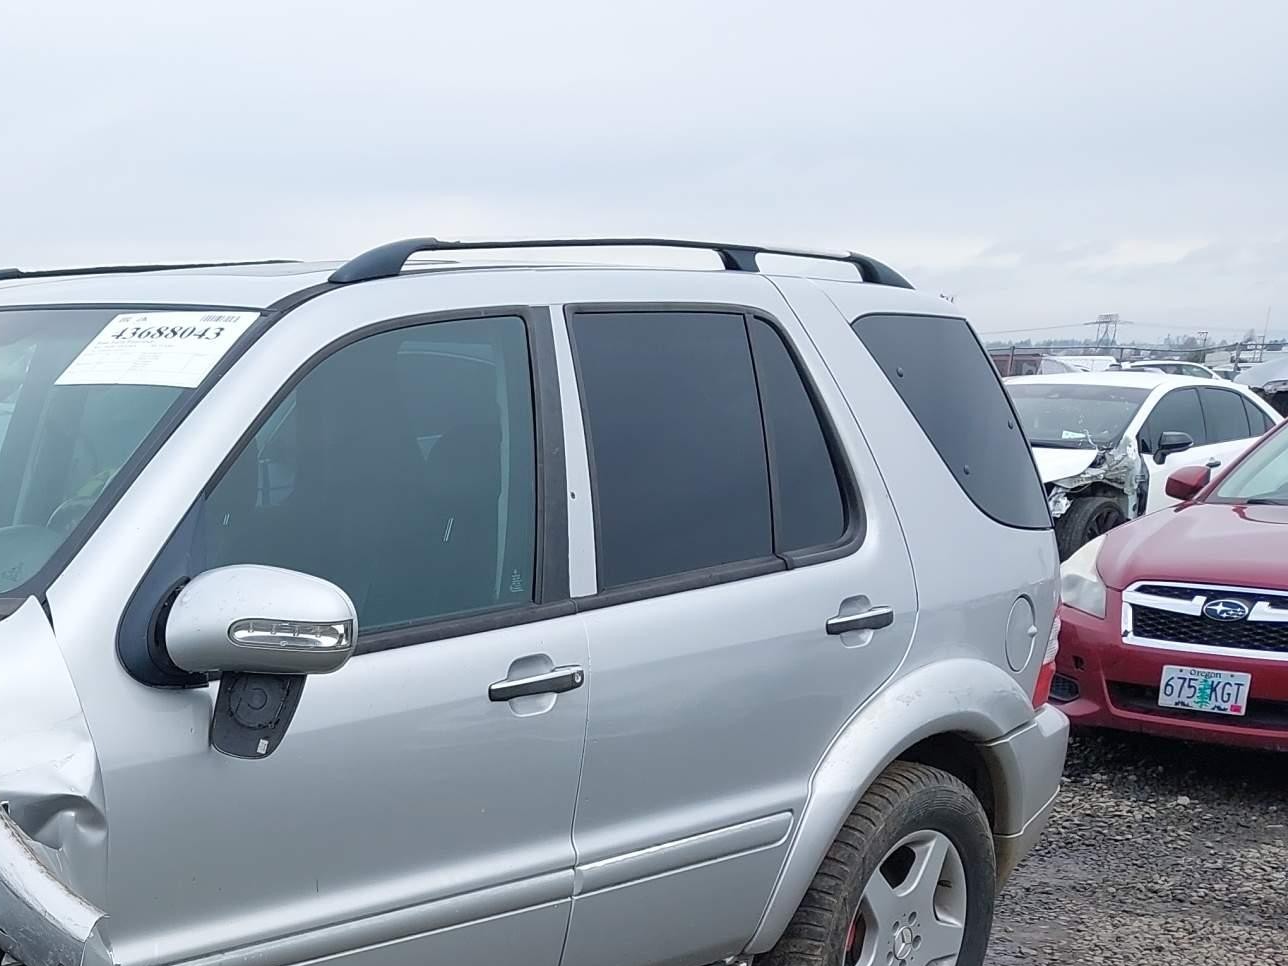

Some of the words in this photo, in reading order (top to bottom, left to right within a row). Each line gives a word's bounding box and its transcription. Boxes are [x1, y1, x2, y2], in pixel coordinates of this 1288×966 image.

[111, 325, 225, 341] 43688043
[1190, 669, 1222, 679] Oregon
[1163, 676, 1199, 699] 675
[1208, 680, 1244, 705] KGT
